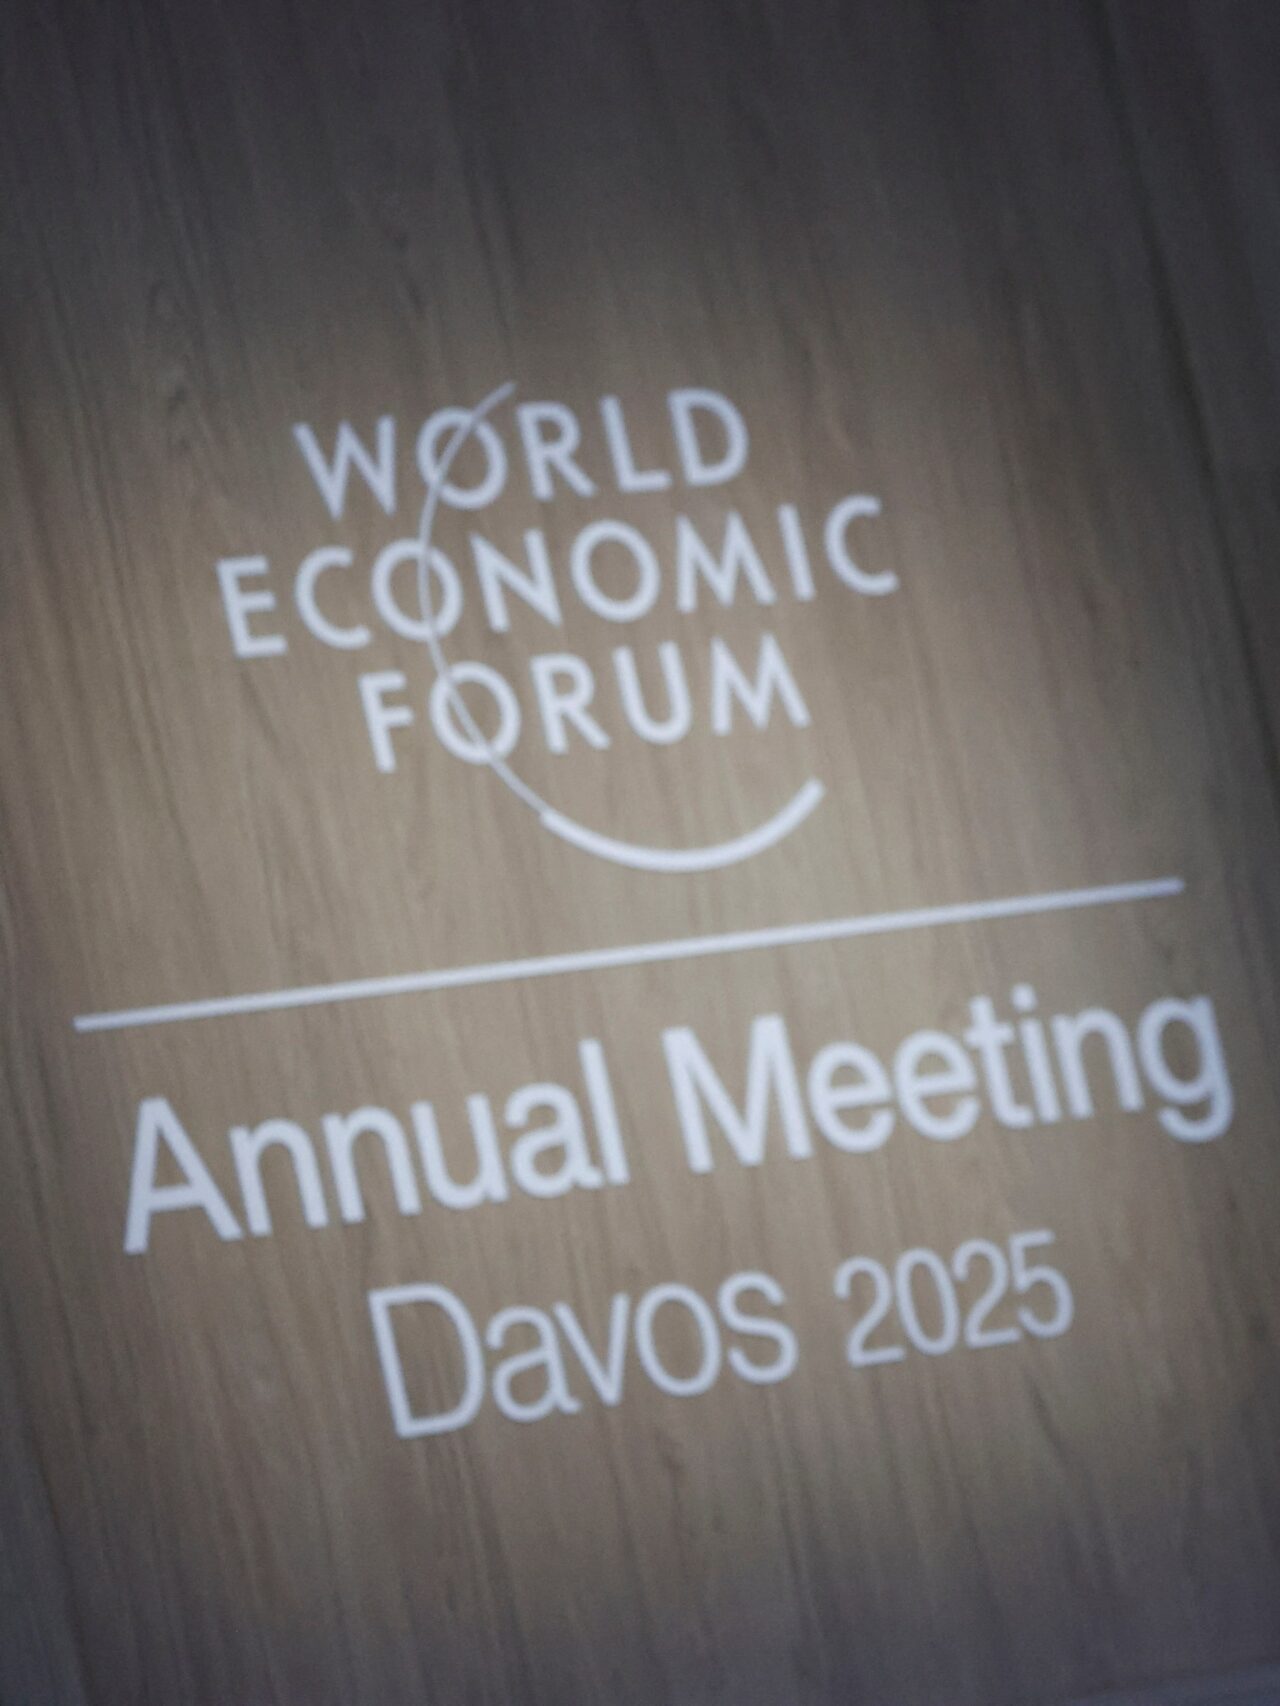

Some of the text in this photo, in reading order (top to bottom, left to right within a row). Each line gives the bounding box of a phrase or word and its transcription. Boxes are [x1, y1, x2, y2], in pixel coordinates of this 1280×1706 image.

[294, 388, 750, 519] WORLD
[217, 496, 899, 660] ECONOMIC
[359, 633, 811, 774] FORUM
[123, 984, 1235, 1254] Annual Meeting
[368, 1230, 1074, 1438] Davos 2025
